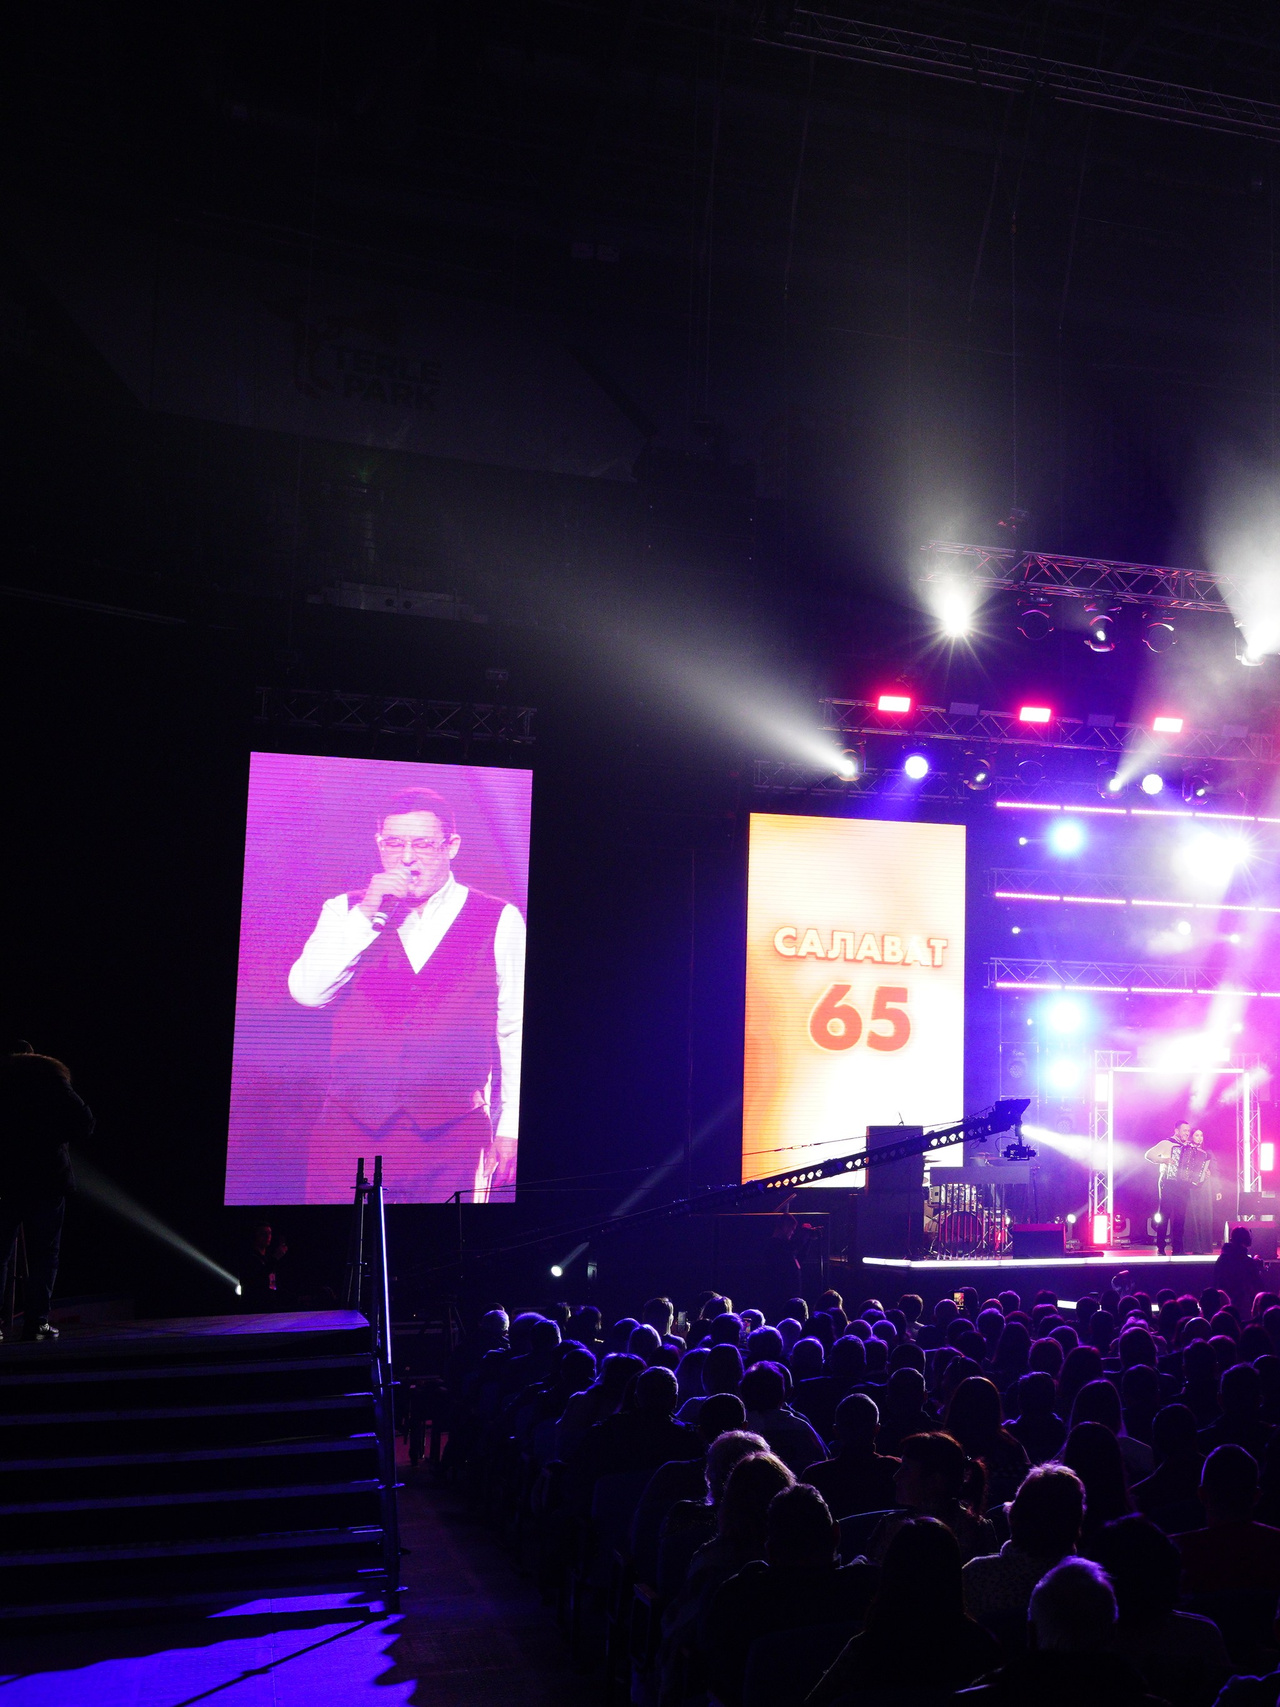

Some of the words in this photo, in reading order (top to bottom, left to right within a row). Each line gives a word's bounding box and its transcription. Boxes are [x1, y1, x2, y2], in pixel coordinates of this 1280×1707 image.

[330, 345, 441, 385] TERLE
[343, 373, 439, 411] PARK
[773, 926, 949, 967] САЛАВАТ
[808, 981, 911, 1052] 65
